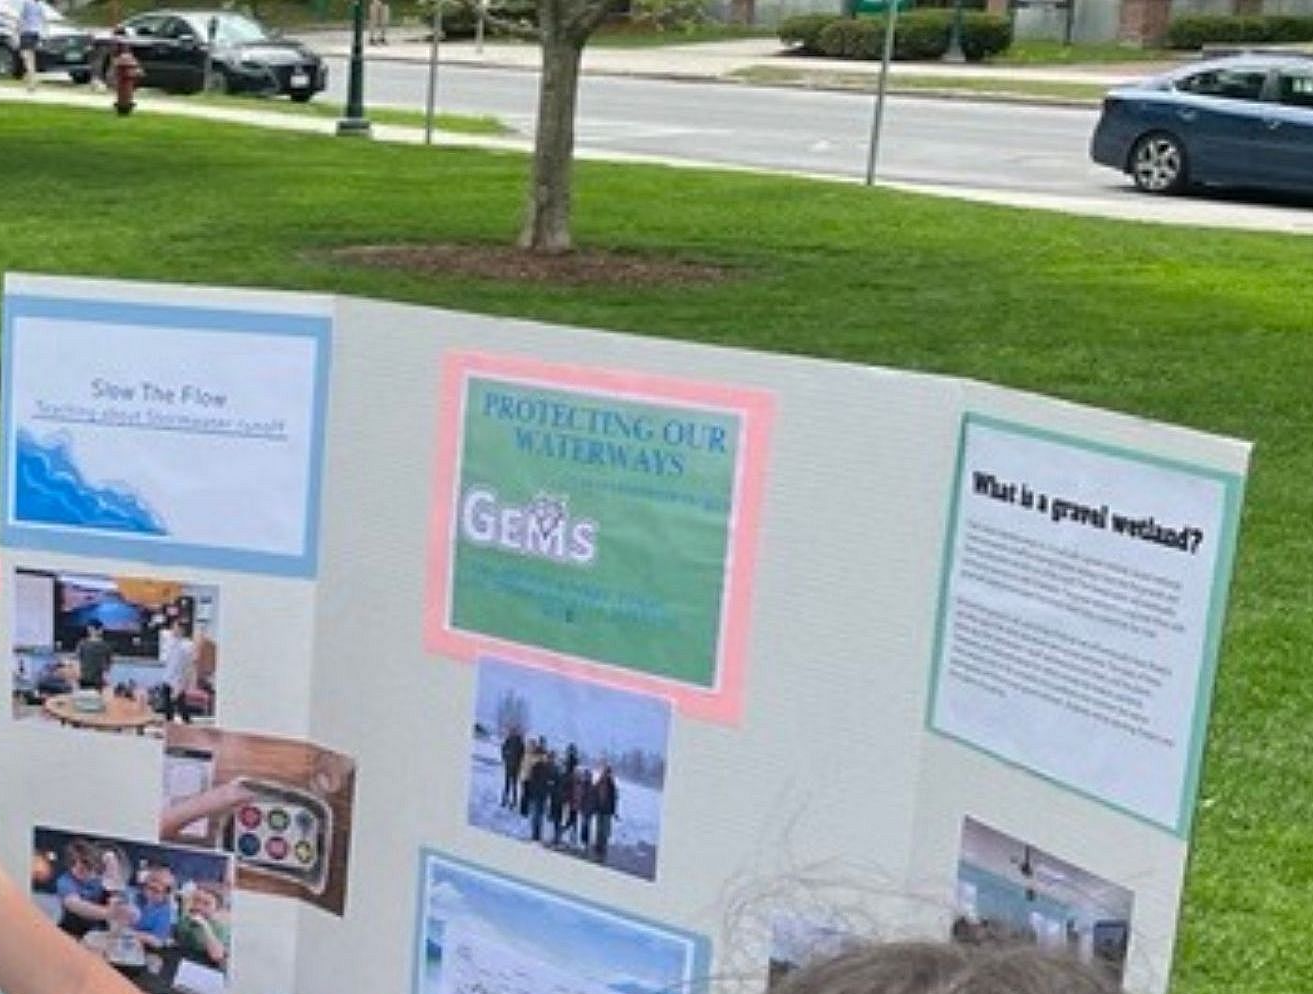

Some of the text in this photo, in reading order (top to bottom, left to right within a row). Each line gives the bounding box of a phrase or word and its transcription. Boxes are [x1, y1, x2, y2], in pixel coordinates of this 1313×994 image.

[91, 377, 227, 409] Slow The Flow
[483, 392, 726, 454] PROTECTING OUR
[513, 427, 686, 476] WATERWAYS
[462, 489, 595, 562] GEMS
[972, 470, 1204, 555] What is a gravel wetland?
